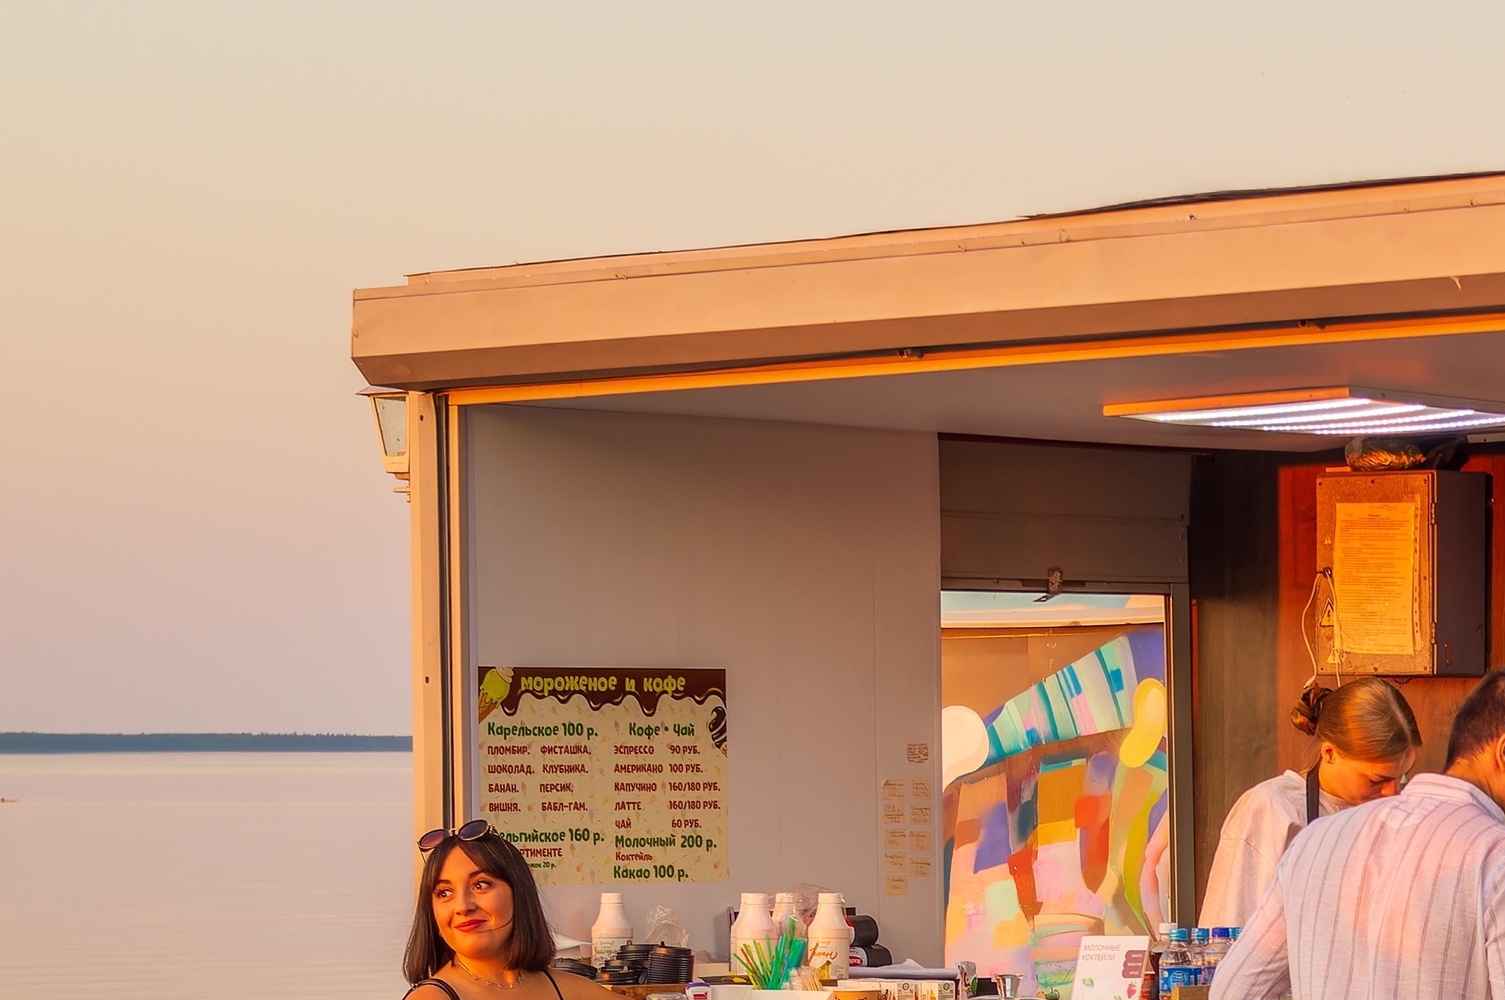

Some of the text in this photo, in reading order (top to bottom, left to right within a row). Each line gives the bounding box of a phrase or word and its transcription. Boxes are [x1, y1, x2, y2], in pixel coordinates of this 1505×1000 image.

[521, 675, 686, 696] мороженое и кофе
[488, 722, 598, 740] Карельское 100 р.
[629, 722, 694, 739] Кофе Чай
[488, 745, 591, 755] ПЛОМБИР. ФИСТАШКА.
[614, 746, 700, 755] ЭСПРЕССО 90 РУБ.
[488, 764, 588, 775] ШОКОЛАД. КЛУБНИКА.
[614, 764, 703, 773] АМЕРИКАНО 100 РУБ.
[489, 784, 519, 793] БАНАН.
[614, 782, 720, 792] КАПУЧИНО 160/180 РУБ.
[489, 802, 588, 812] ВИШНЯ. БАБЛ-ГАМ.
[614, 801, 720, 811] ЛАТТЕ 160/180 РУБ.
[615, 818, 701, 829] ЧАЙ 60 РУБ.
[500, 828, 604, 845] ельгийское 160 р.
[615, 834, 716, 851] Молочный 200 р.
[521, 848, 562, 858] РТИМЕНТЕ
[616, 852, 652, 861] Коктейль
[614, 865, 688, 881] Какао 100 р.
